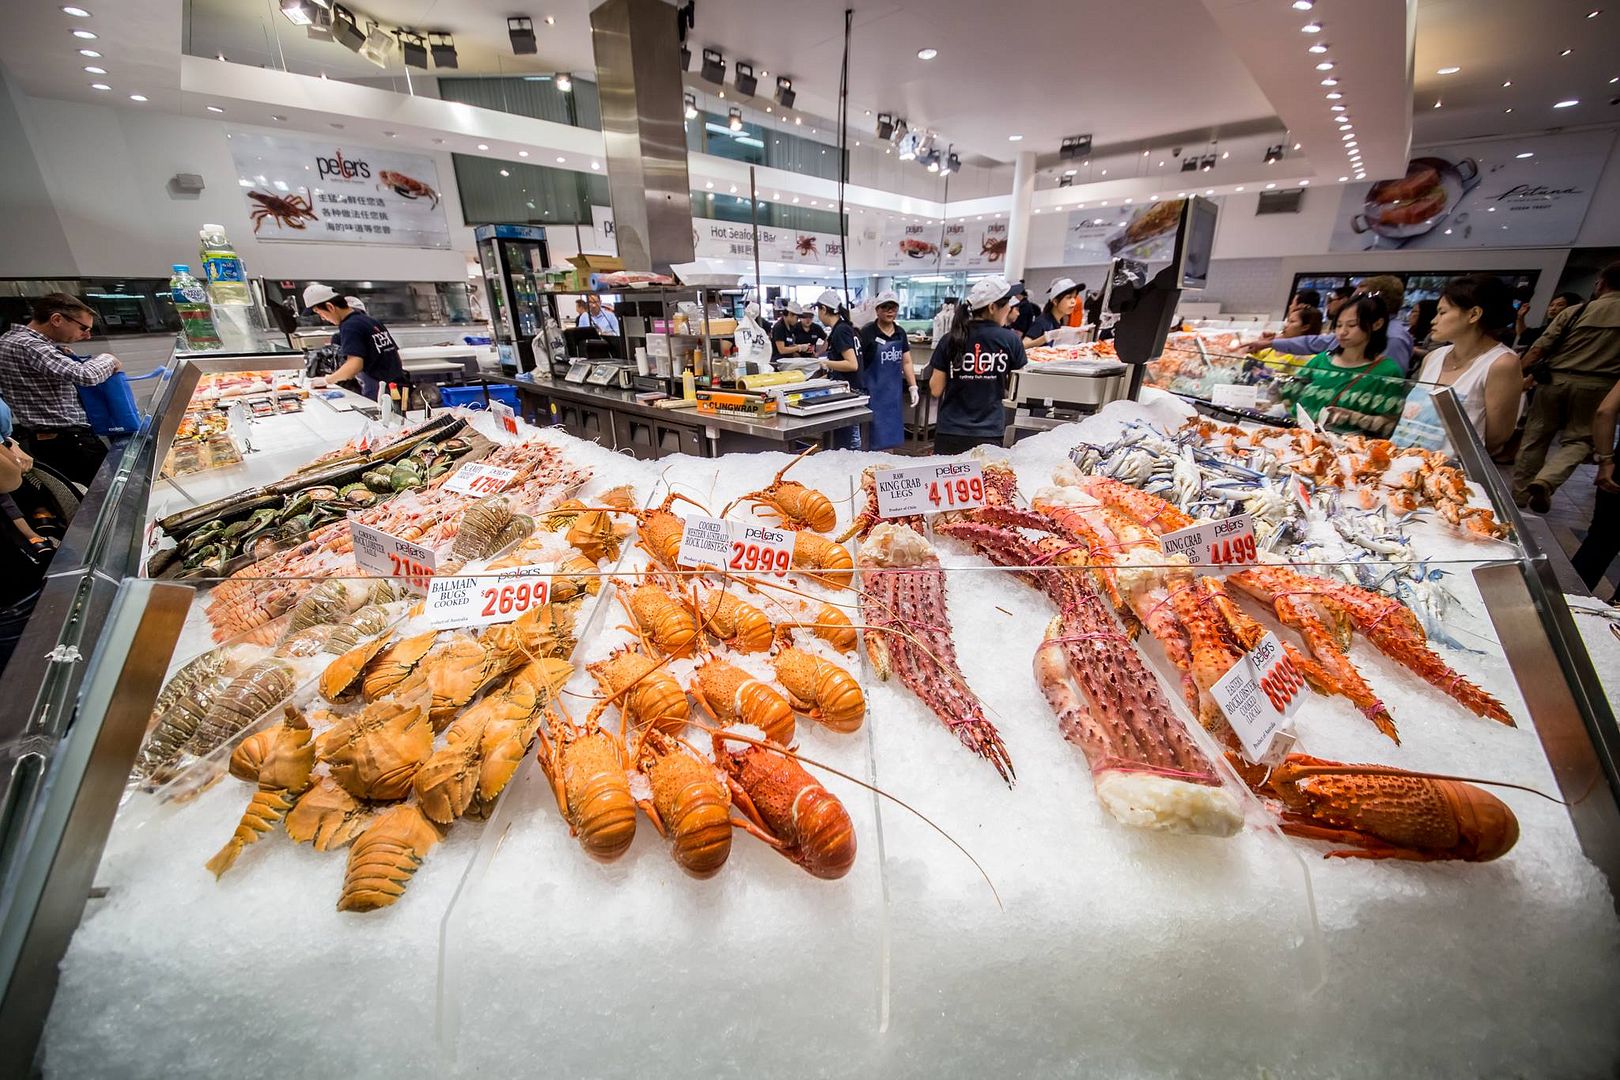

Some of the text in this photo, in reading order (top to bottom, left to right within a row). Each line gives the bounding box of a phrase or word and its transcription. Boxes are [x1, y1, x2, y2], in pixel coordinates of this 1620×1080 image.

[710, 226, 777, 242] Hot Seafod Bar
[709, 401, 759, 413] CLINGWRAP
[879, 478, 921, 492] KING CRAB
[891, 489, 914, 499] LEGS
[699, 520, 721, 532] COOKED
[359, 530, 377, 542] GREEN
[685, 537, 701, 548] ROCK
[1164, 538, 1184, 553] KING
[1184, 533, 1203, 548] CRAB
[431, 577, 478, 593] BALMAIN
[440, 590, 466, 600] BUGS
[434, 598, 470, 609] COOKED
